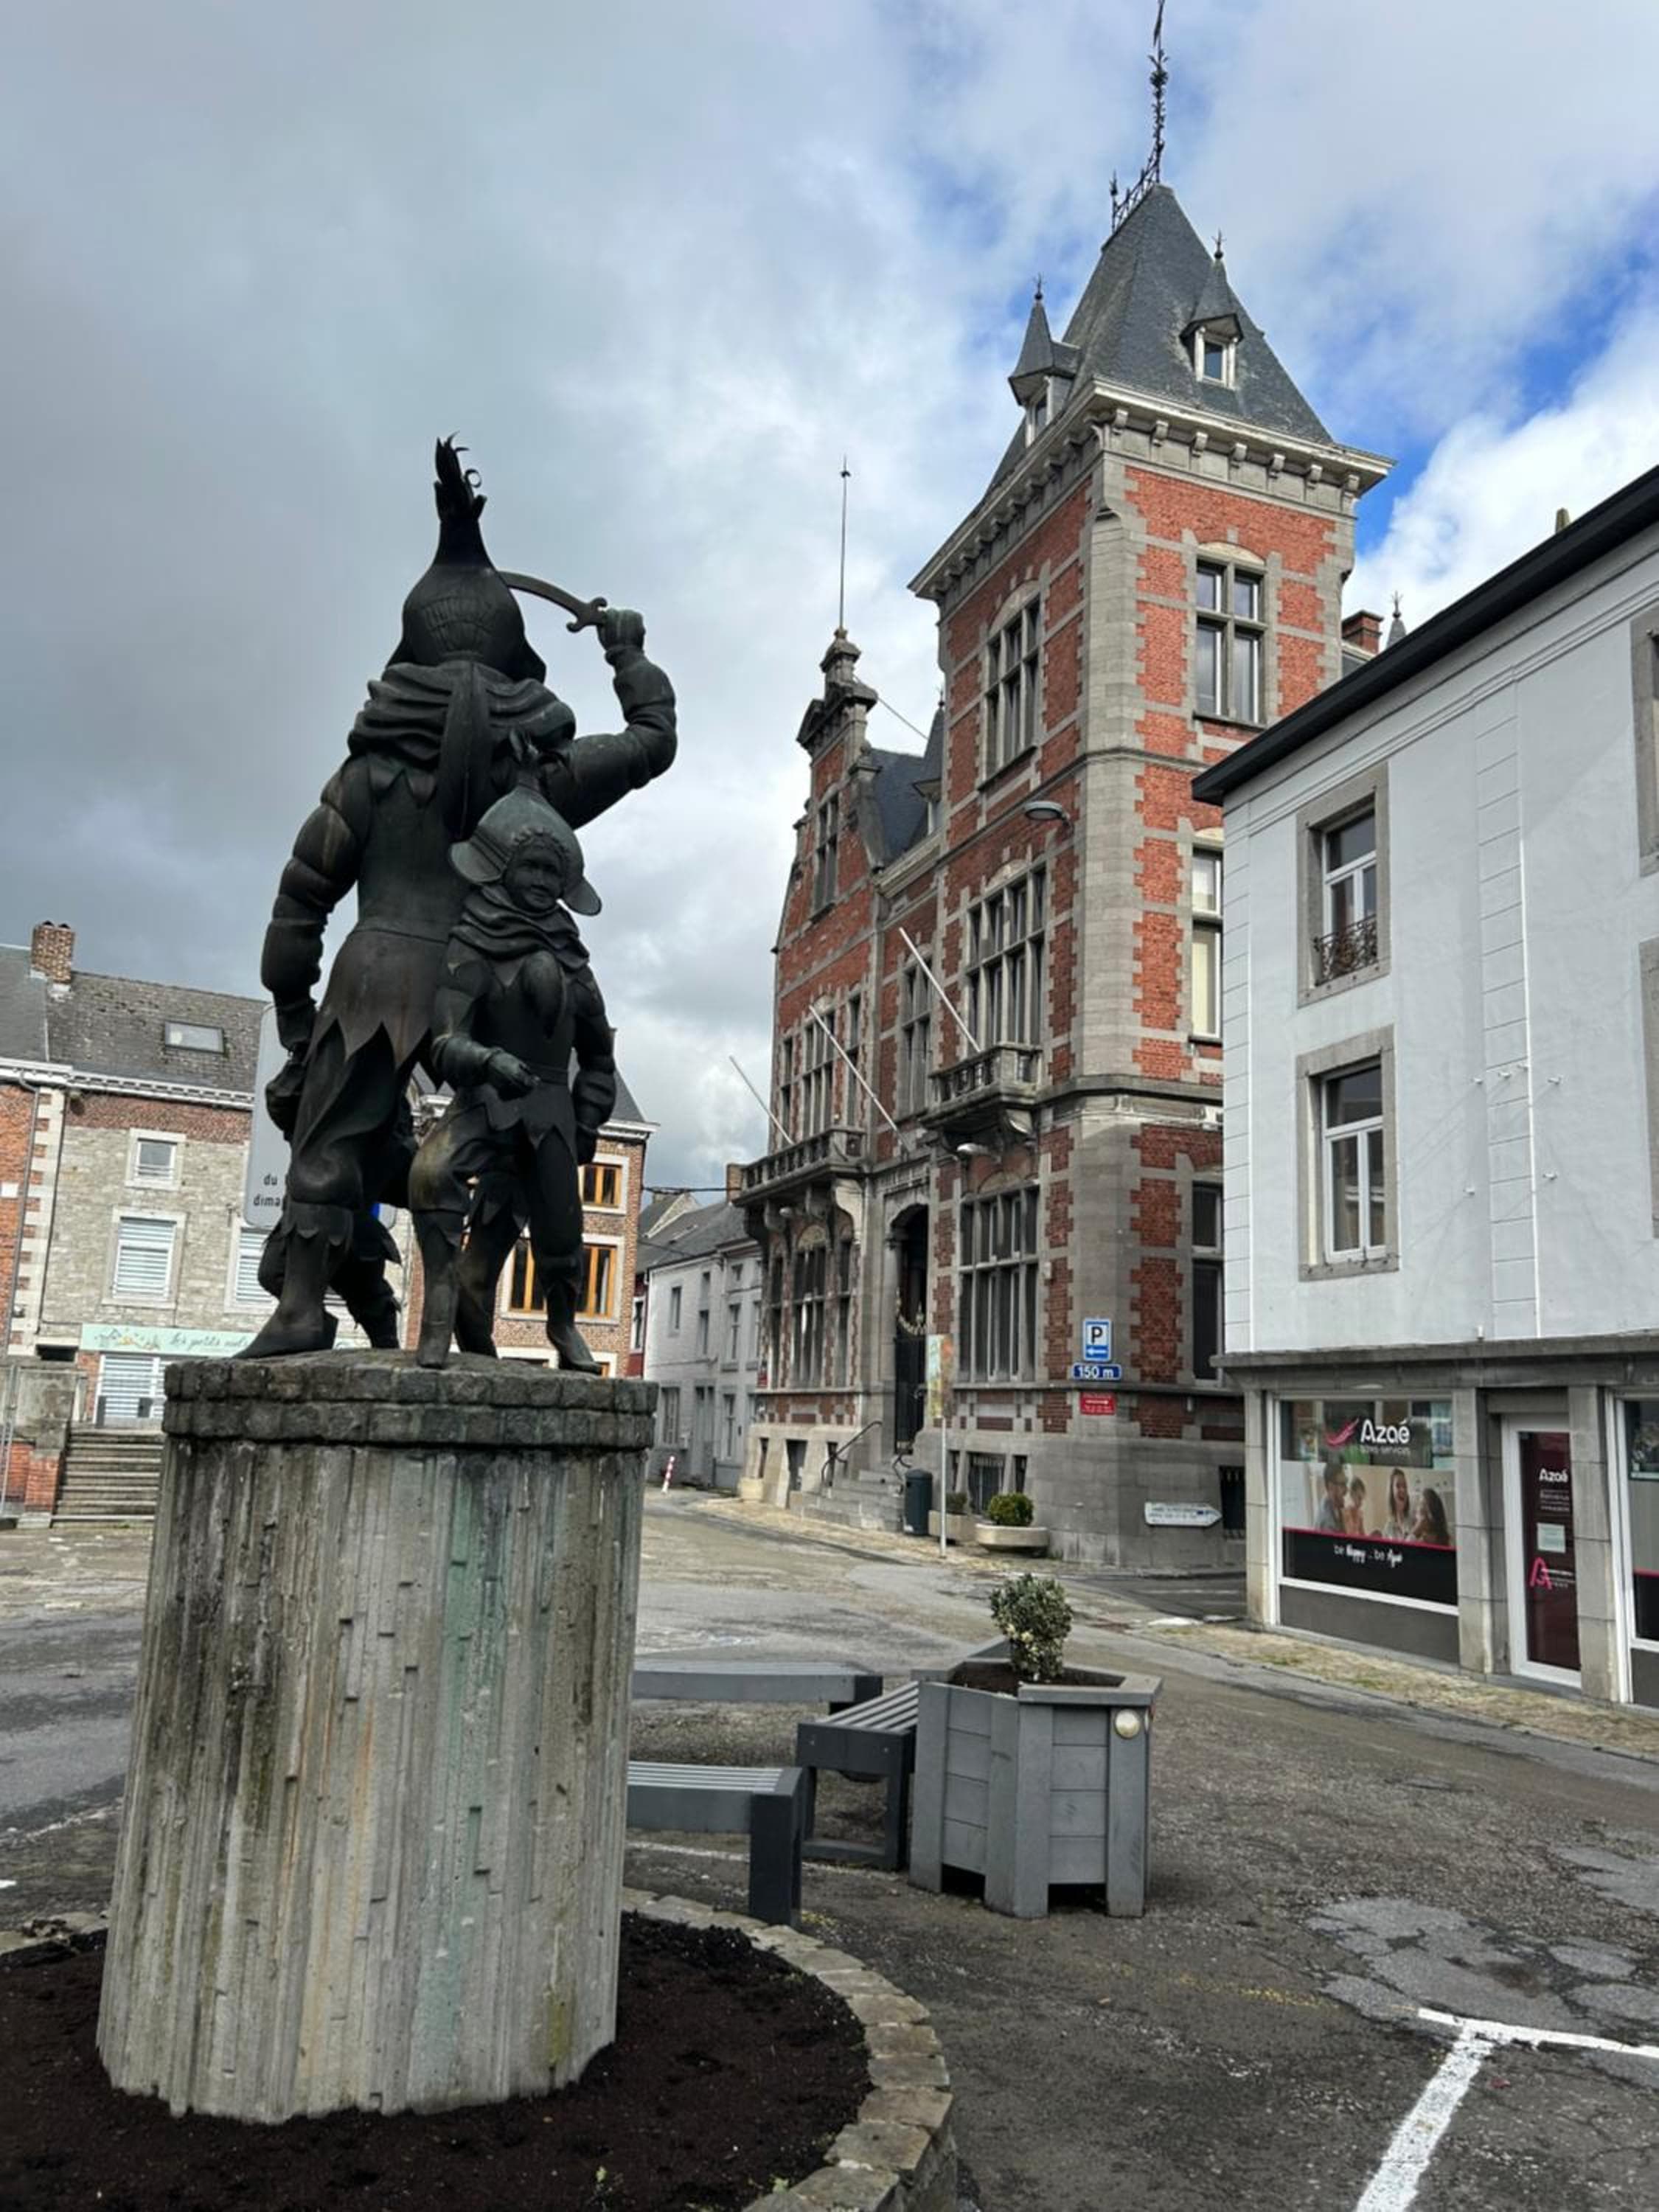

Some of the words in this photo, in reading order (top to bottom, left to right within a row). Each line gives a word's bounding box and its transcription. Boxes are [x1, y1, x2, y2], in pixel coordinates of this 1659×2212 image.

[263, 1173, 278, 1186] du
[253, 1194, 281, 1207] dima
[1091, 1326, 1103, 1344] P
[1078, 1366, 1099, 1379] 150
[1102, 1368, 1114, 1378] m
[1360, 1418, 1411, 1444] Azaé
[1539, 1468, 1568, 1483] Azaé
